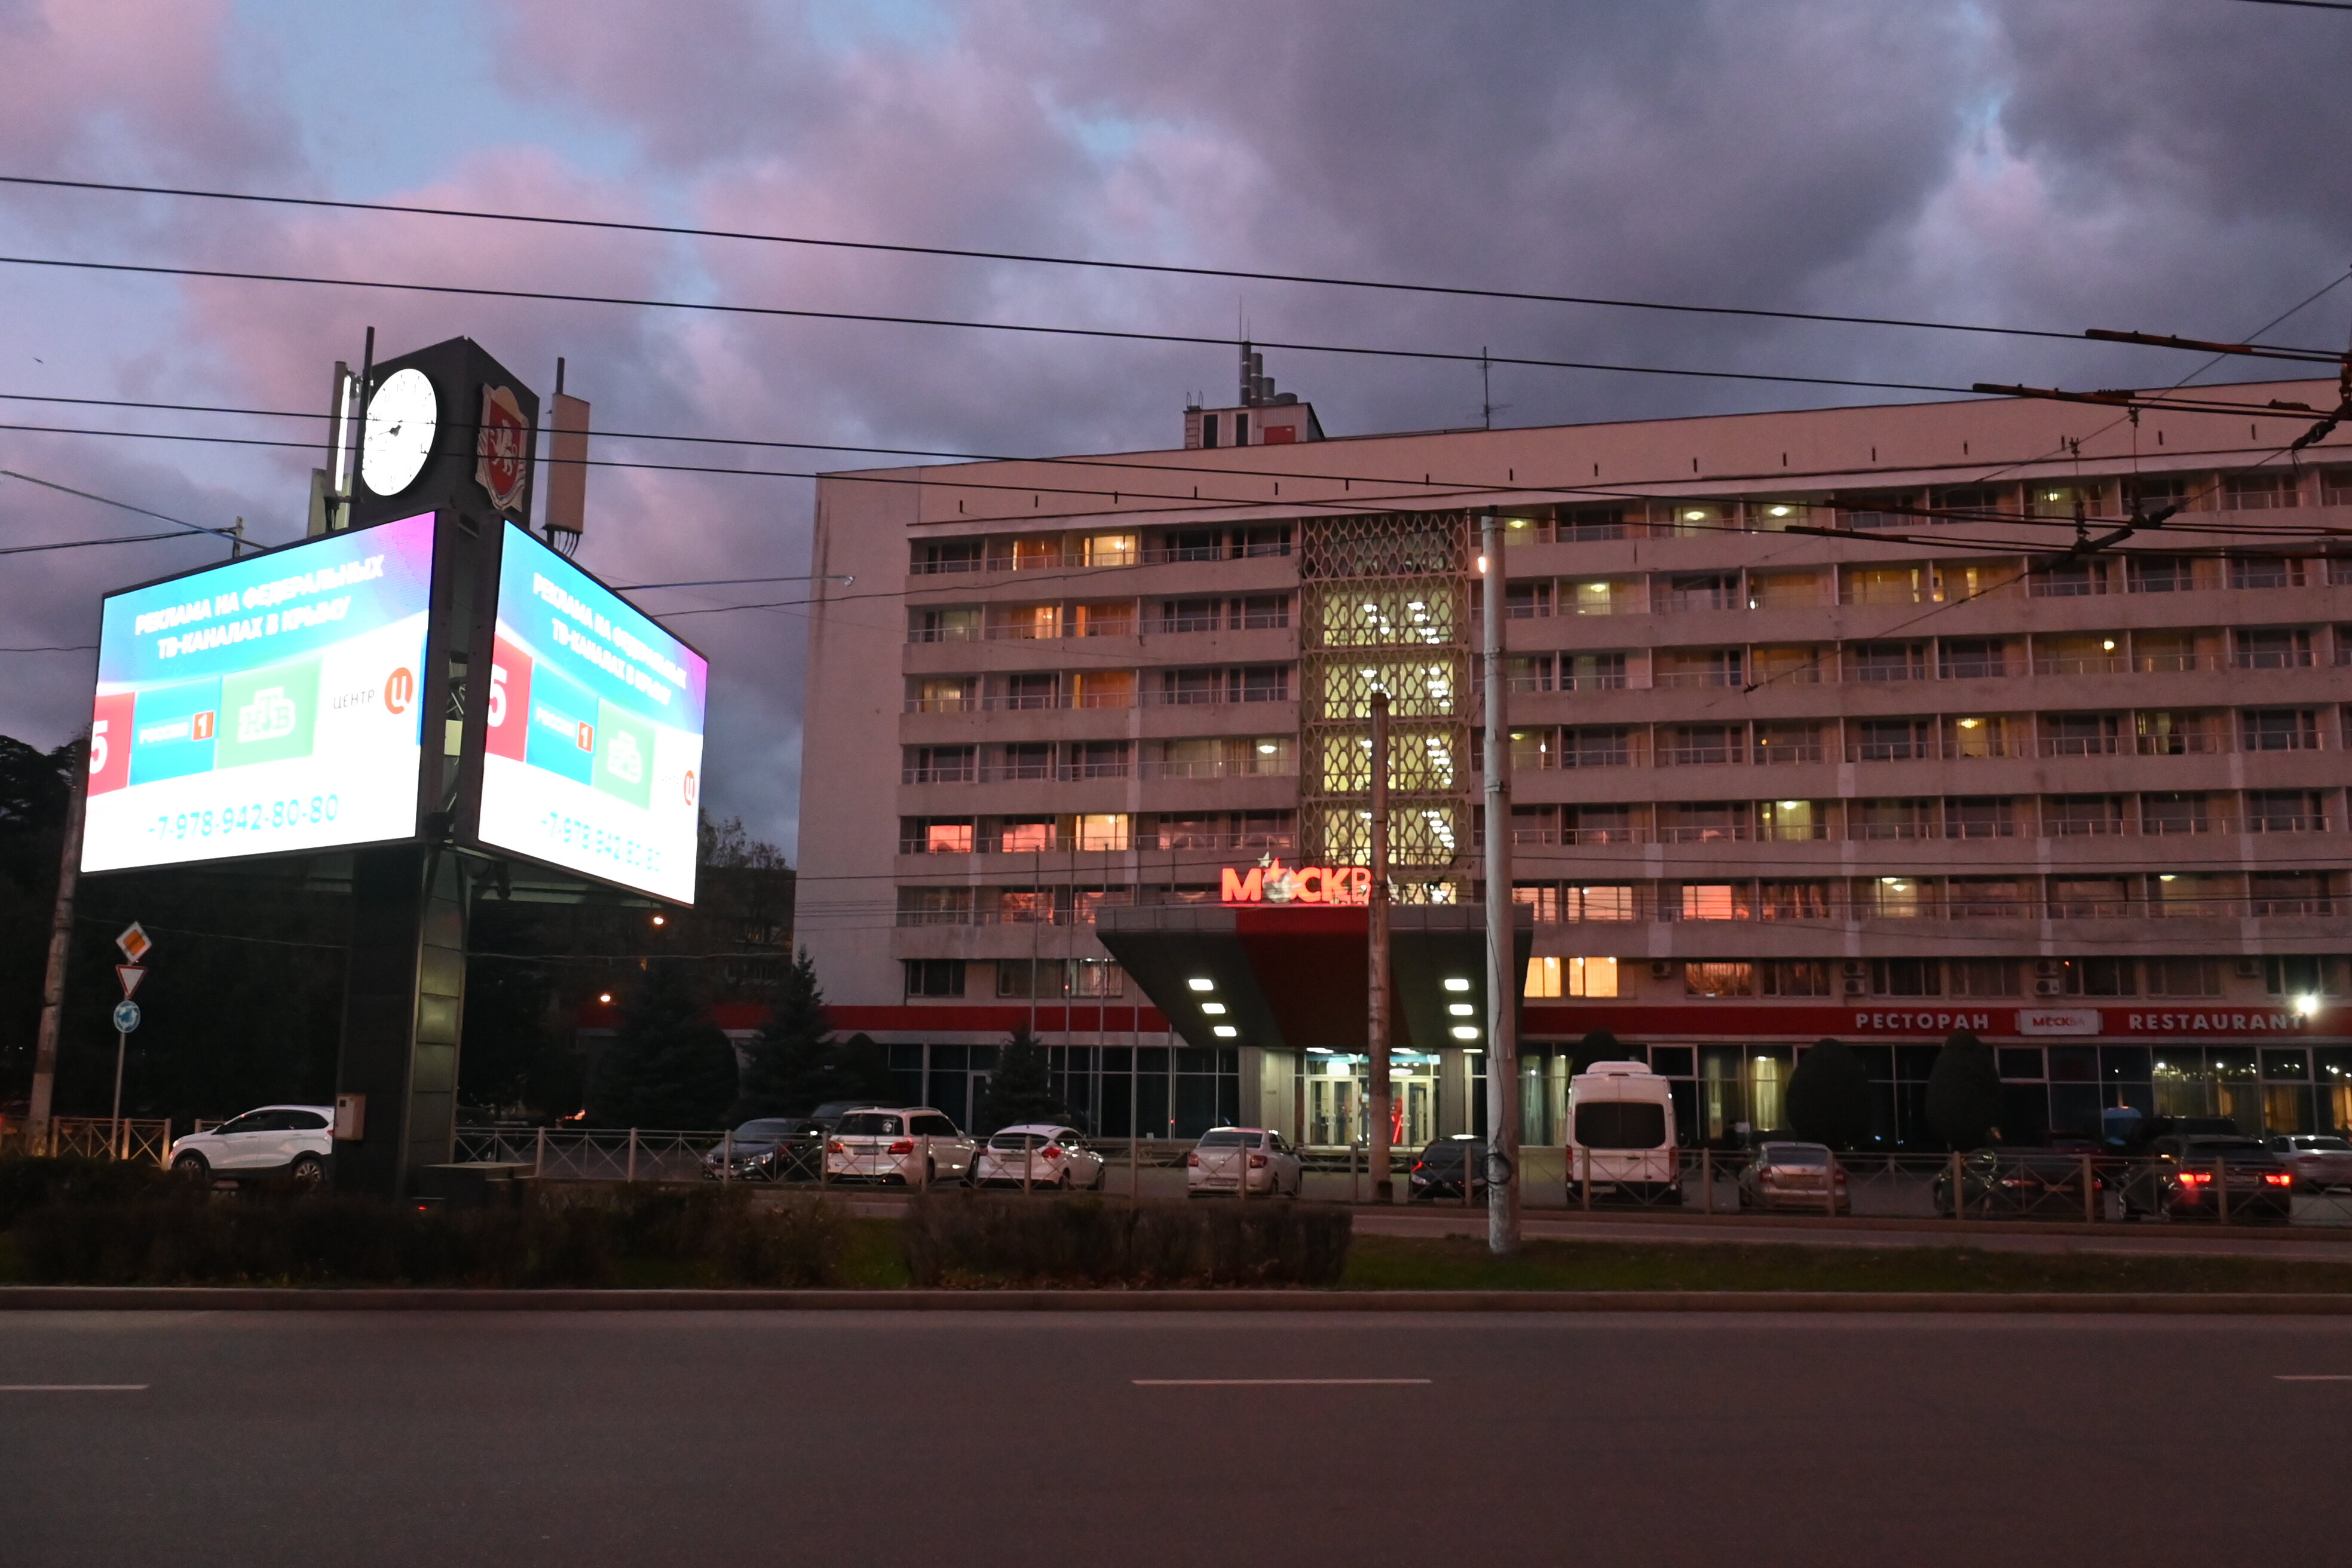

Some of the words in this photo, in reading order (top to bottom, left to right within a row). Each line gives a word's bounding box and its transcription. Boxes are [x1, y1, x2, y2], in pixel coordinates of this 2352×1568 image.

[135, 599, 212, 635] РЕКЛАМА
[215, 592, 239, 616] НА
[242, 555, 384, 609] ФЕДЕРАЛЬНЫХ
[158, 616, 263, 659] ТВ-КАНАЛАХ
[266, 613, 279, 635] В
[333, 690, 375, 709] ЦЕНТР
[488, 664, 507, 727] 5
[198, 714, 207, 737] 1
[581, 726, 588, 748] 1
[90, 720, 108, 773] 5
[1855, 1013, 1989, 1030] РЕСТОРАН
[2129, 1013, 2304, 1030] RESTAURANT
